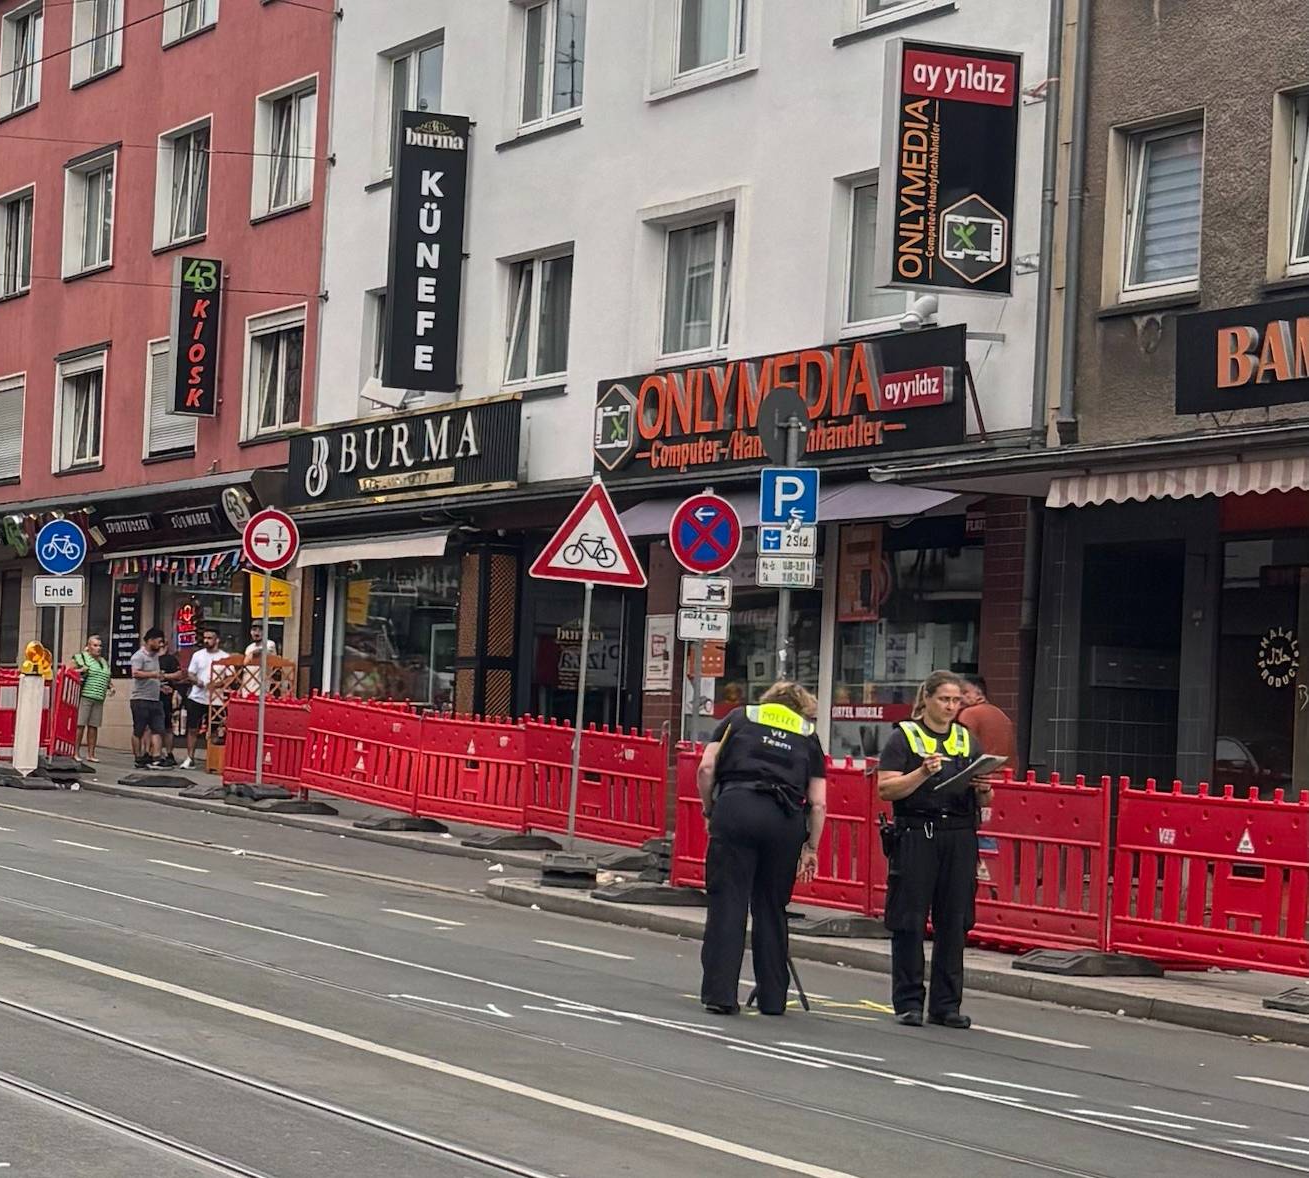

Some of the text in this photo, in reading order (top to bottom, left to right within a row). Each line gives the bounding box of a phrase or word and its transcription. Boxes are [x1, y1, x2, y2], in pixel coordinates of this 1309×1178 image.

[912, 63, 1006, 94] ay yıldız
[405, 126, 465, 151] burma
[897, 98, 931, 280] ONLYMEDIA
[413, 169, 445, 372] KÜNEFE
[185, 298, 211, 408] KIOSK
[884, 373, 940, 406] ay yıldız
[339, 410, 479, 474] BURMA
[774, 475, 806, 517] P
[785, 534, 811, 548] 2 Std.
[44, 585, 73, 597] Ende
[1260, 626, 1299, 651] HALAL
[1258, 660, 1299, 688] PRODUCT
[761, 735, 793, 751] Team
